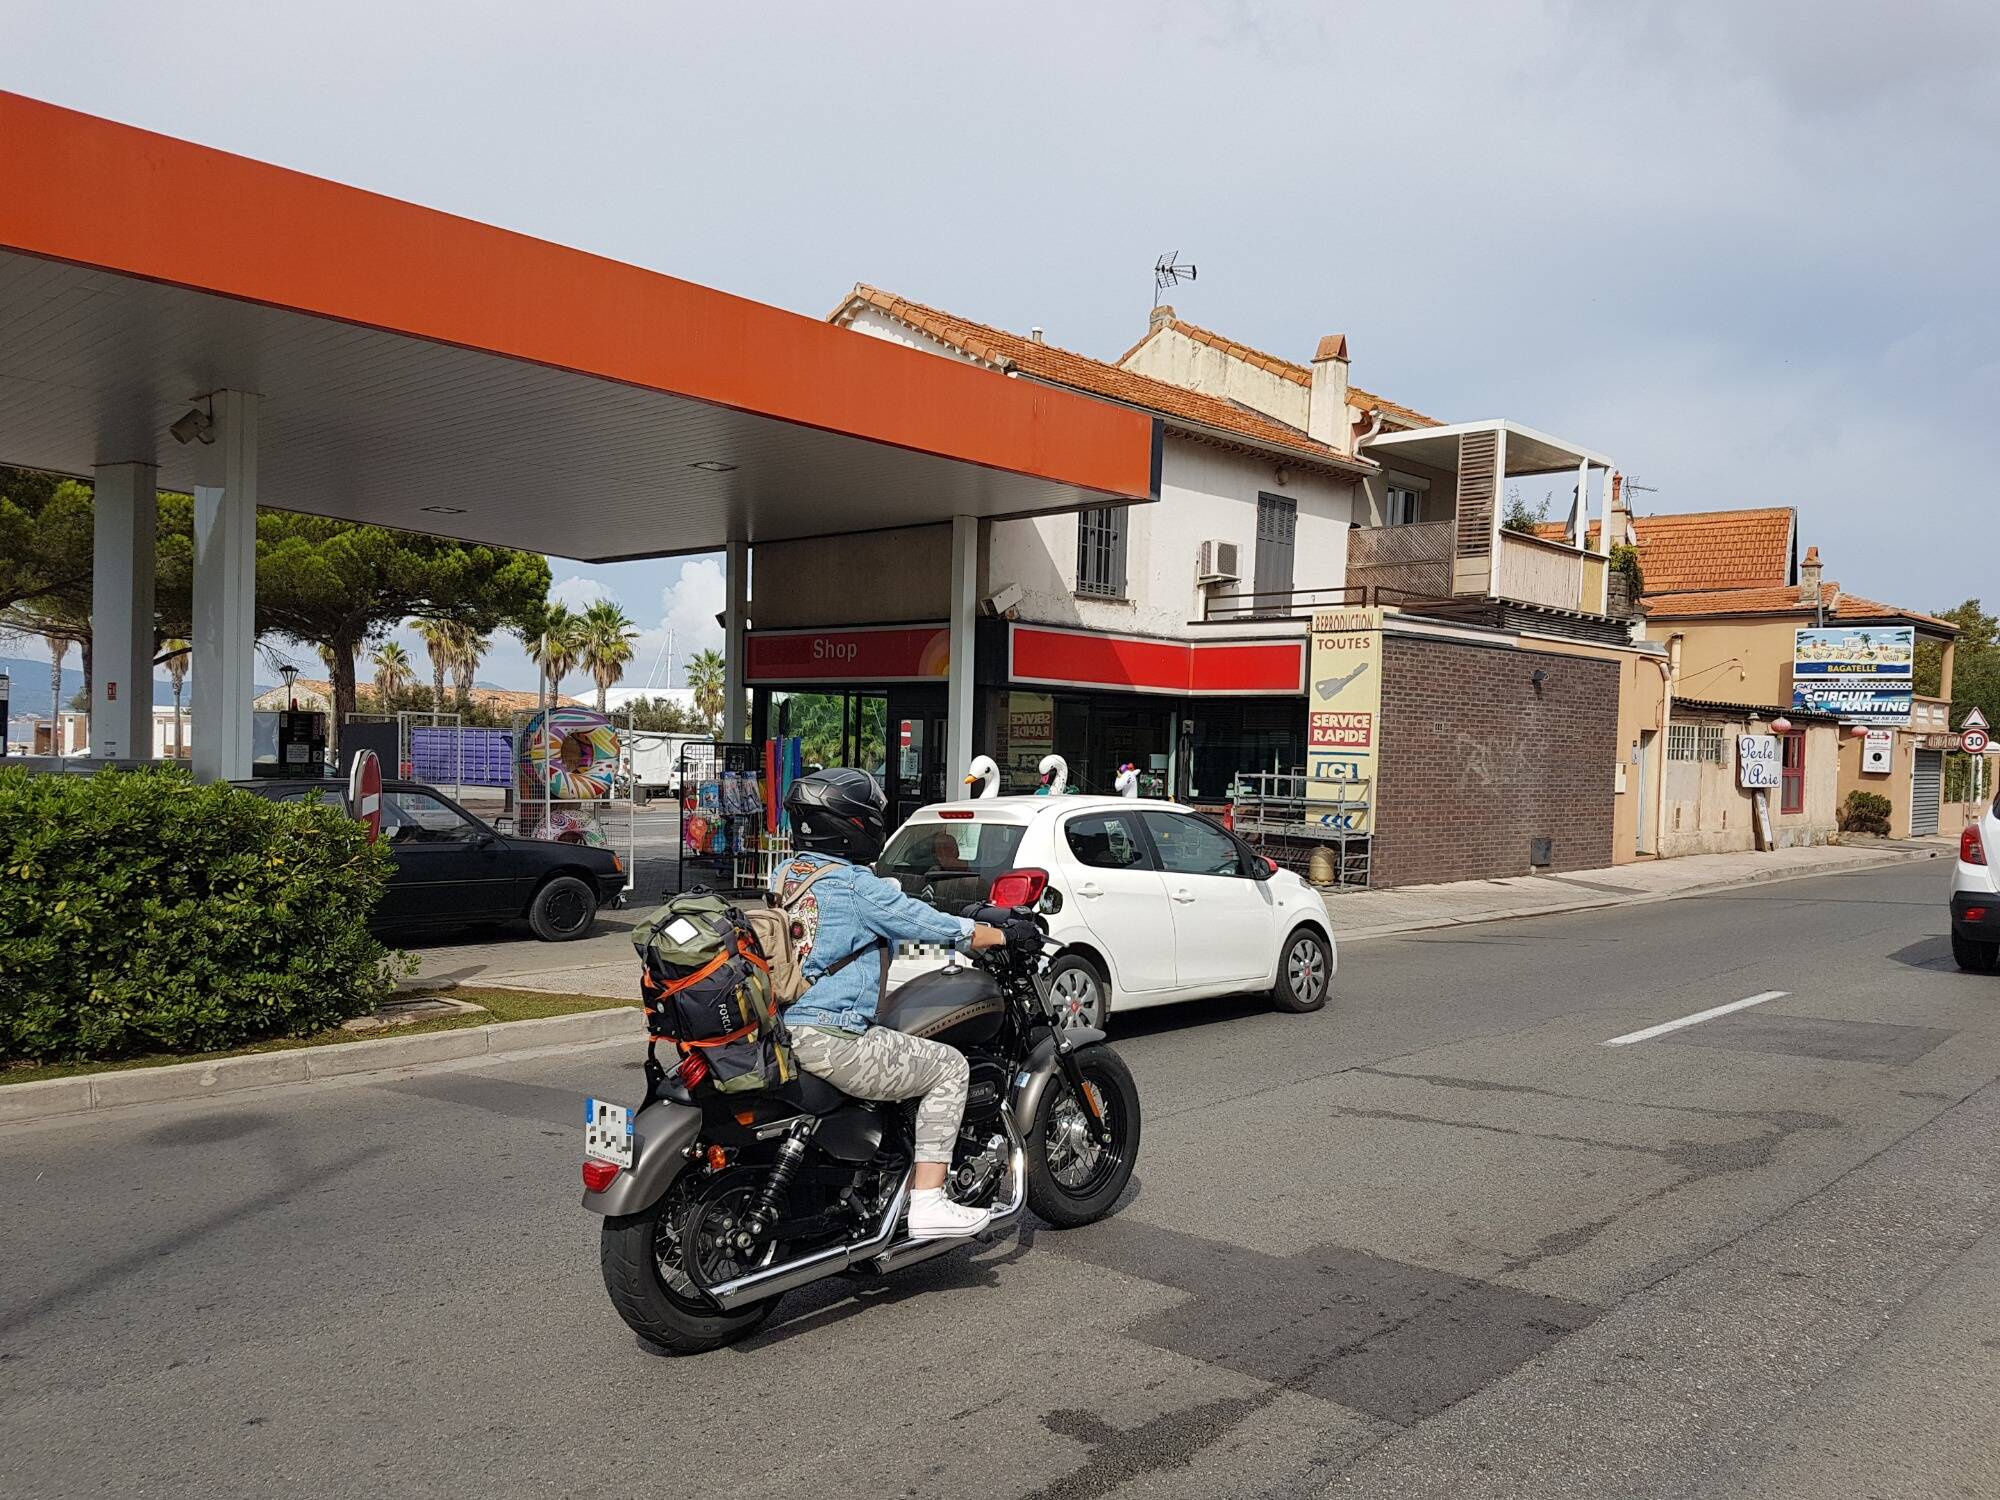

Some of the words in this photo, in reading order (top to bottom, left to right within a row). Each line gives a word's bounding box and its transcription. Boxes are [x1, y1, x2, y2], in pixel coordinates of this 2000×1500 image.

[1315, 613, 1374, 631] REPRODUCTION
[813, 638, 858, 662] Shop
[1316, 637, 1370, 650] TOUTES
[1827, 664, 1877, 673] BAGATELLE
[1813, 691, 1876, 702] CIRCUIT
[1840, 702, 1910, 711] KARTING
[1312, 714, 1370, 728] SERVICE
[1313, 728, 1368, 743] RAPIDE
[1967, 737, 1983, 747] 30
[1741, 737, 1774, 759] Perle
